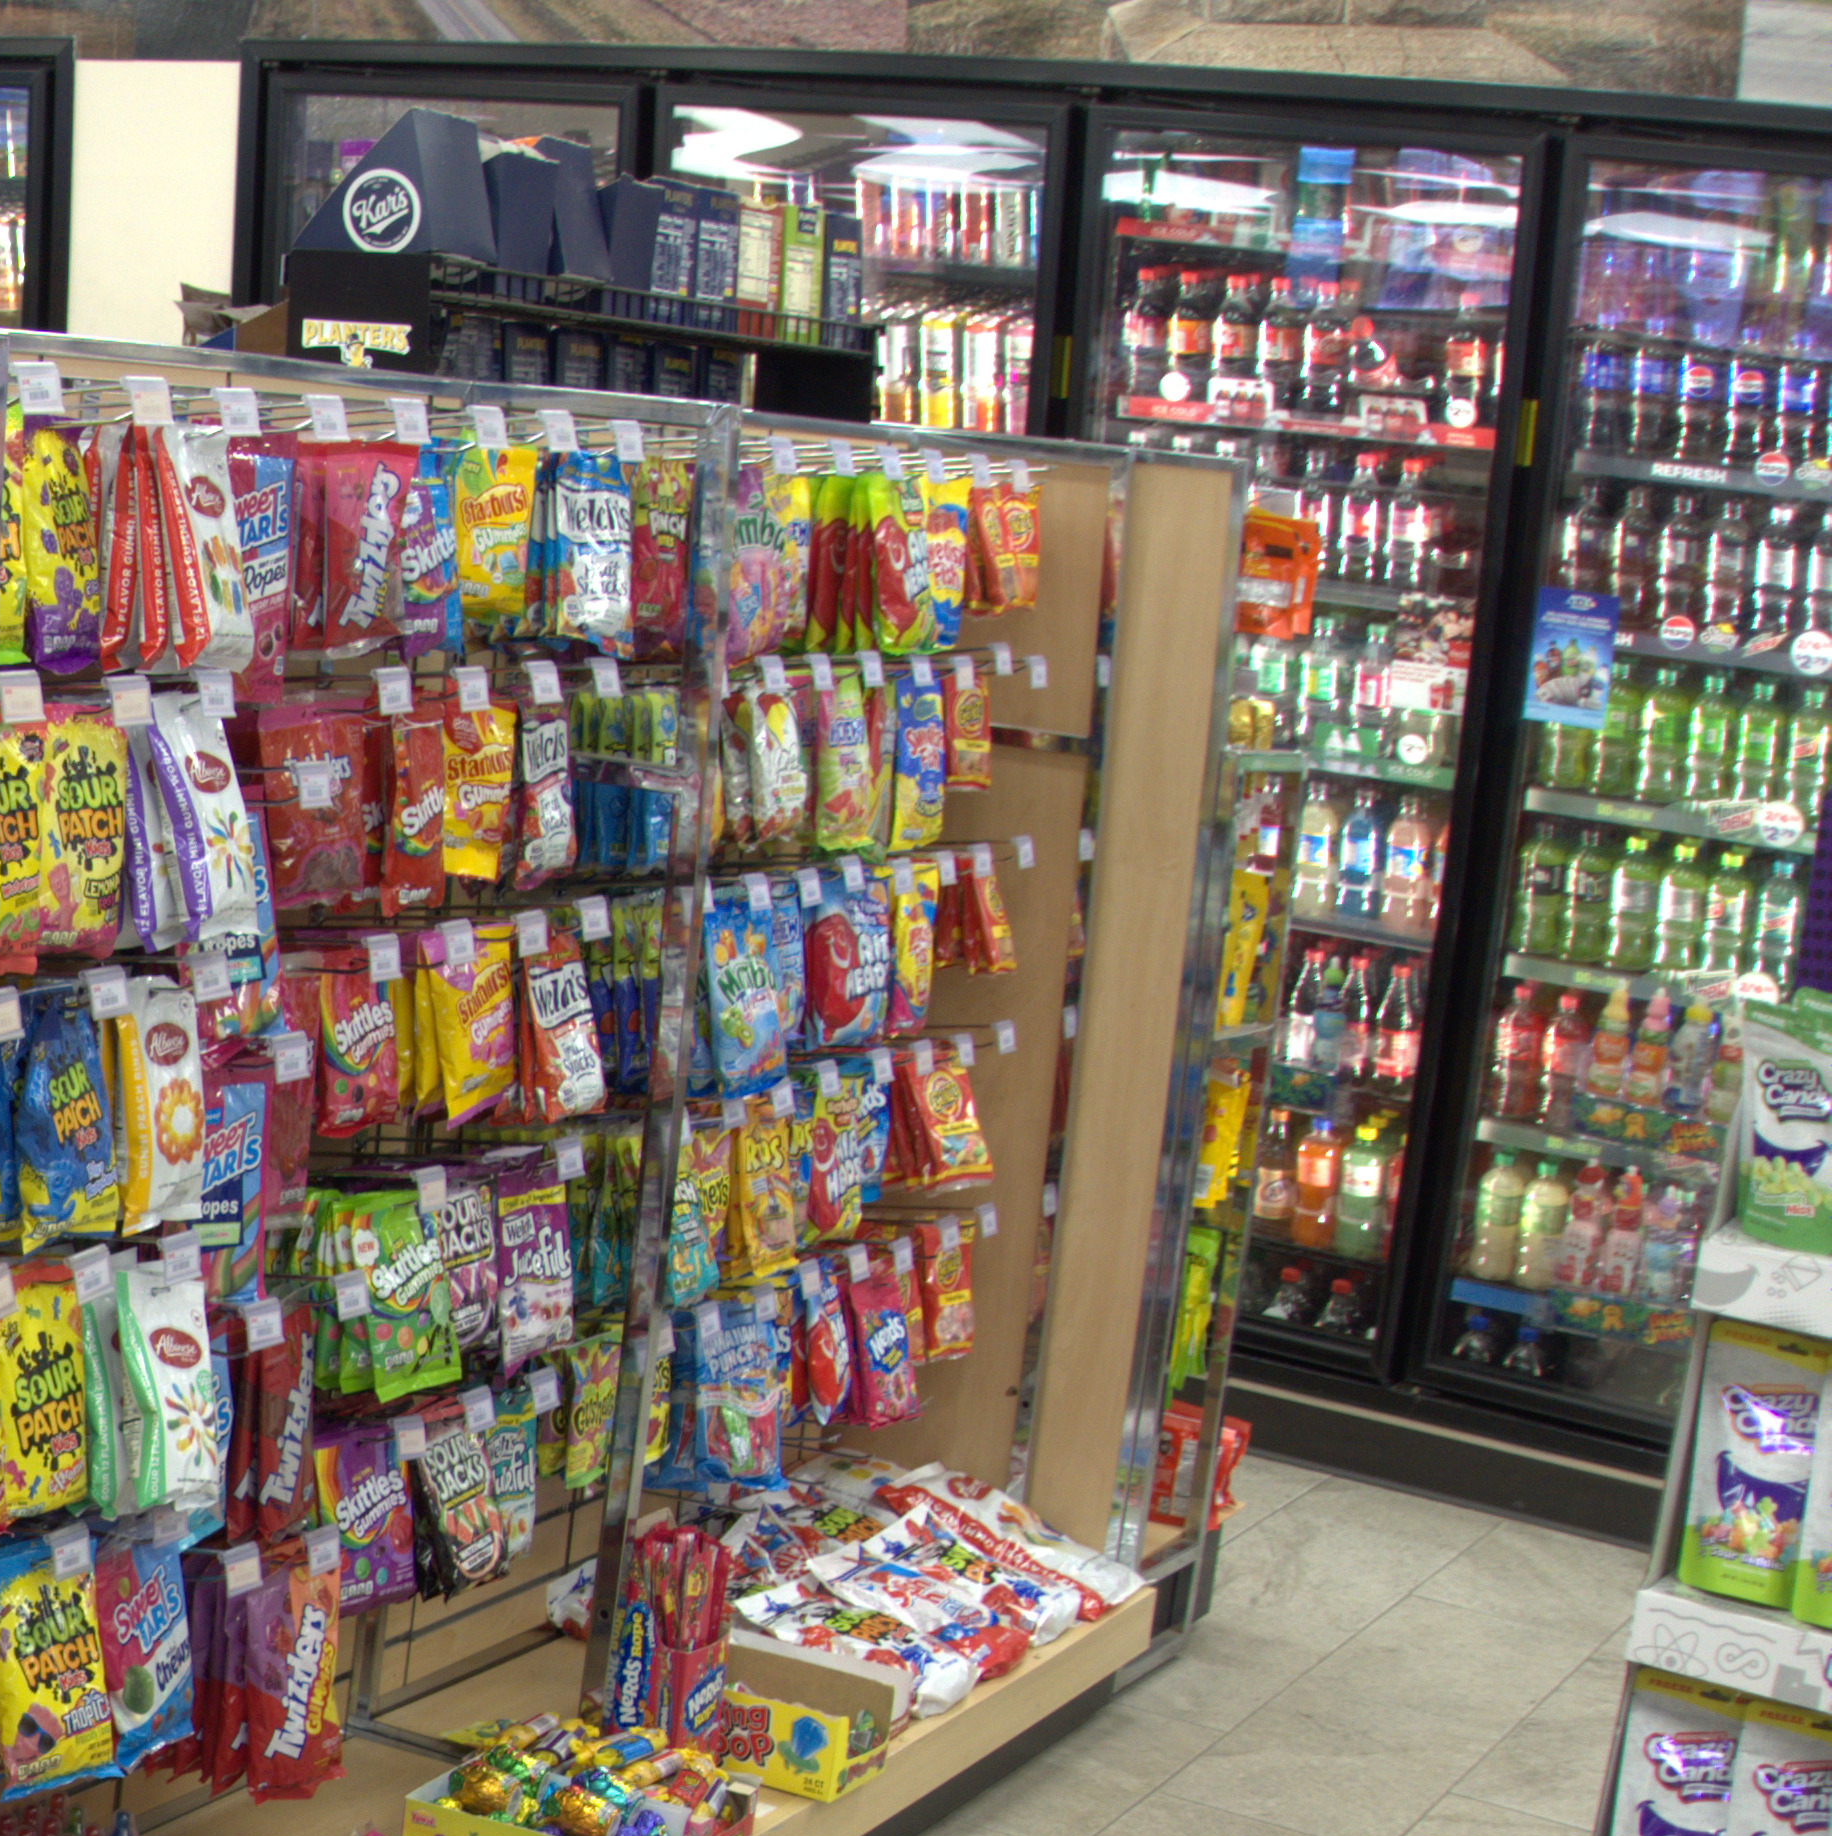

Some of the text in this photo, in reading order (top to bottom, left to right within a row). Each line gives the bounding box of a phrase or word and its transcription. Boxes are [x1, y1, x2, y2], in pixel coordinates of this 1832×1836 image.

[352, 187, 410, 234] Kar's
[303, 319, 410, 355] PLANTERS
[1652, 462, 1728, 483] REFRESH
[57, 776, 118, 809] SOUR
[60, 809, 122, 839] PATCH
[335, 1003, 392, 1049] Skittles
[1758, 1061, 1820, 1092] Crazy
[52, 1098, 103, 1143] PATCH
[371, 1241, 442, 1298] Skittles
[337, 1471, 404, 1534] Skittles
[14, 1613, 83, 1644] SOUR
[23, 1642, 96, 1682] PATCH
[264, 1607, 326, 1760] Twizzlers
